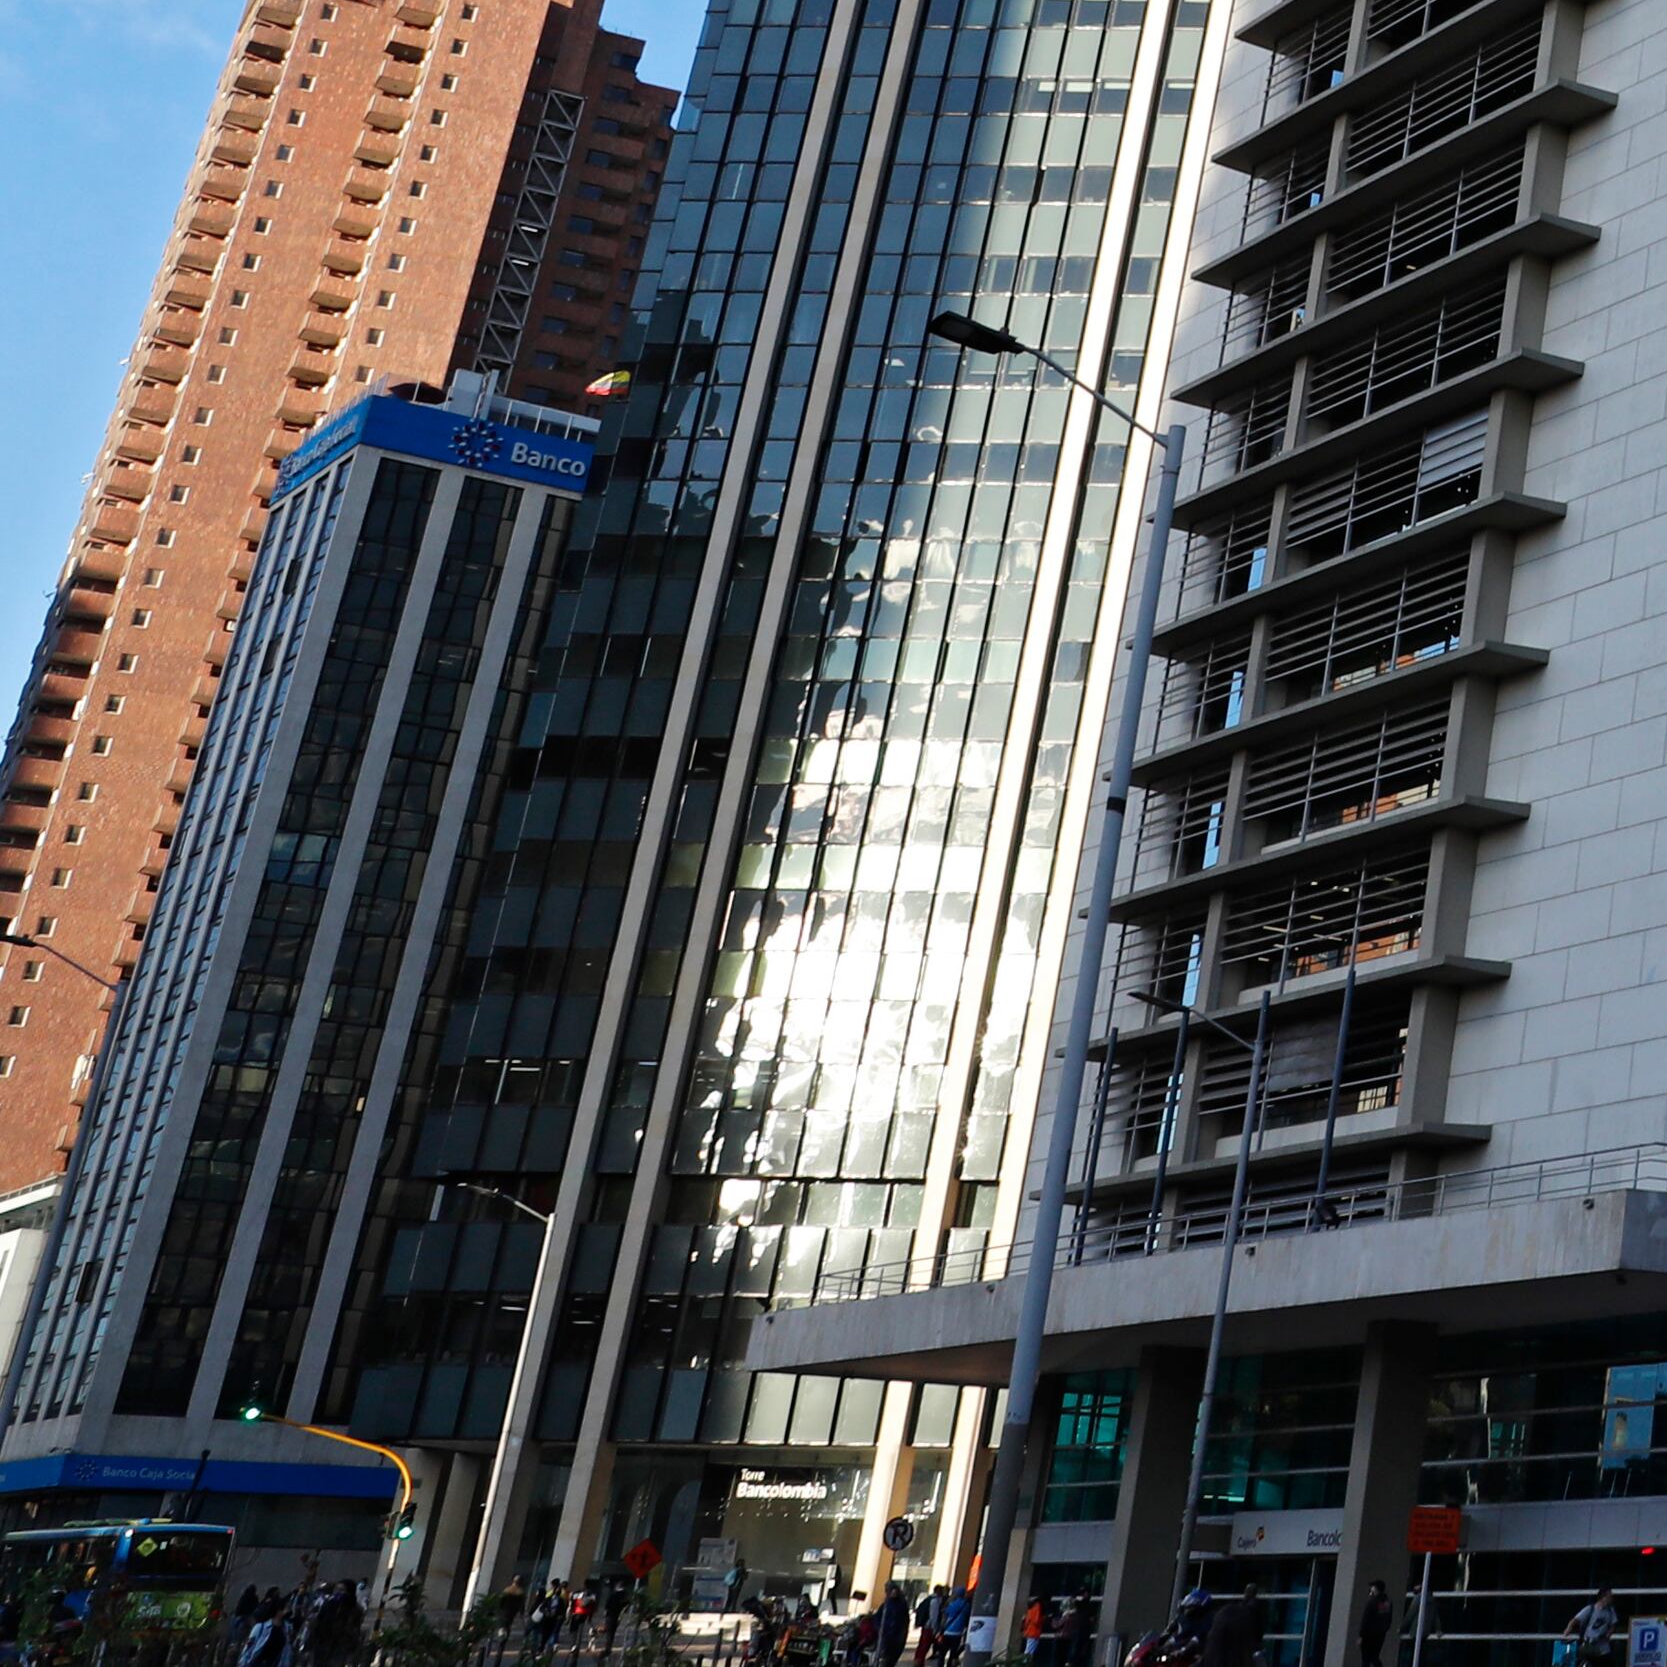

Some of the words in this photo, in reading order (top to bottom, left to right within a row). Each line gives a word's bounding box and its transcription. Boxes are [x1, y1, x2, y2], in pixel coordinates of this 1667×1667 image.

[511, 441, 586, 476] Banco
[102, 1466, 137, 1478] Banco
[139, 1467, 164, 1480] Caja
[166, 1469, 196, 1481] Socia
[741, 1468, 765, 1481] Torre
[736, 1481, 827, 1499] Bancolombia
[1643, 1631, 1655, 1649] P
